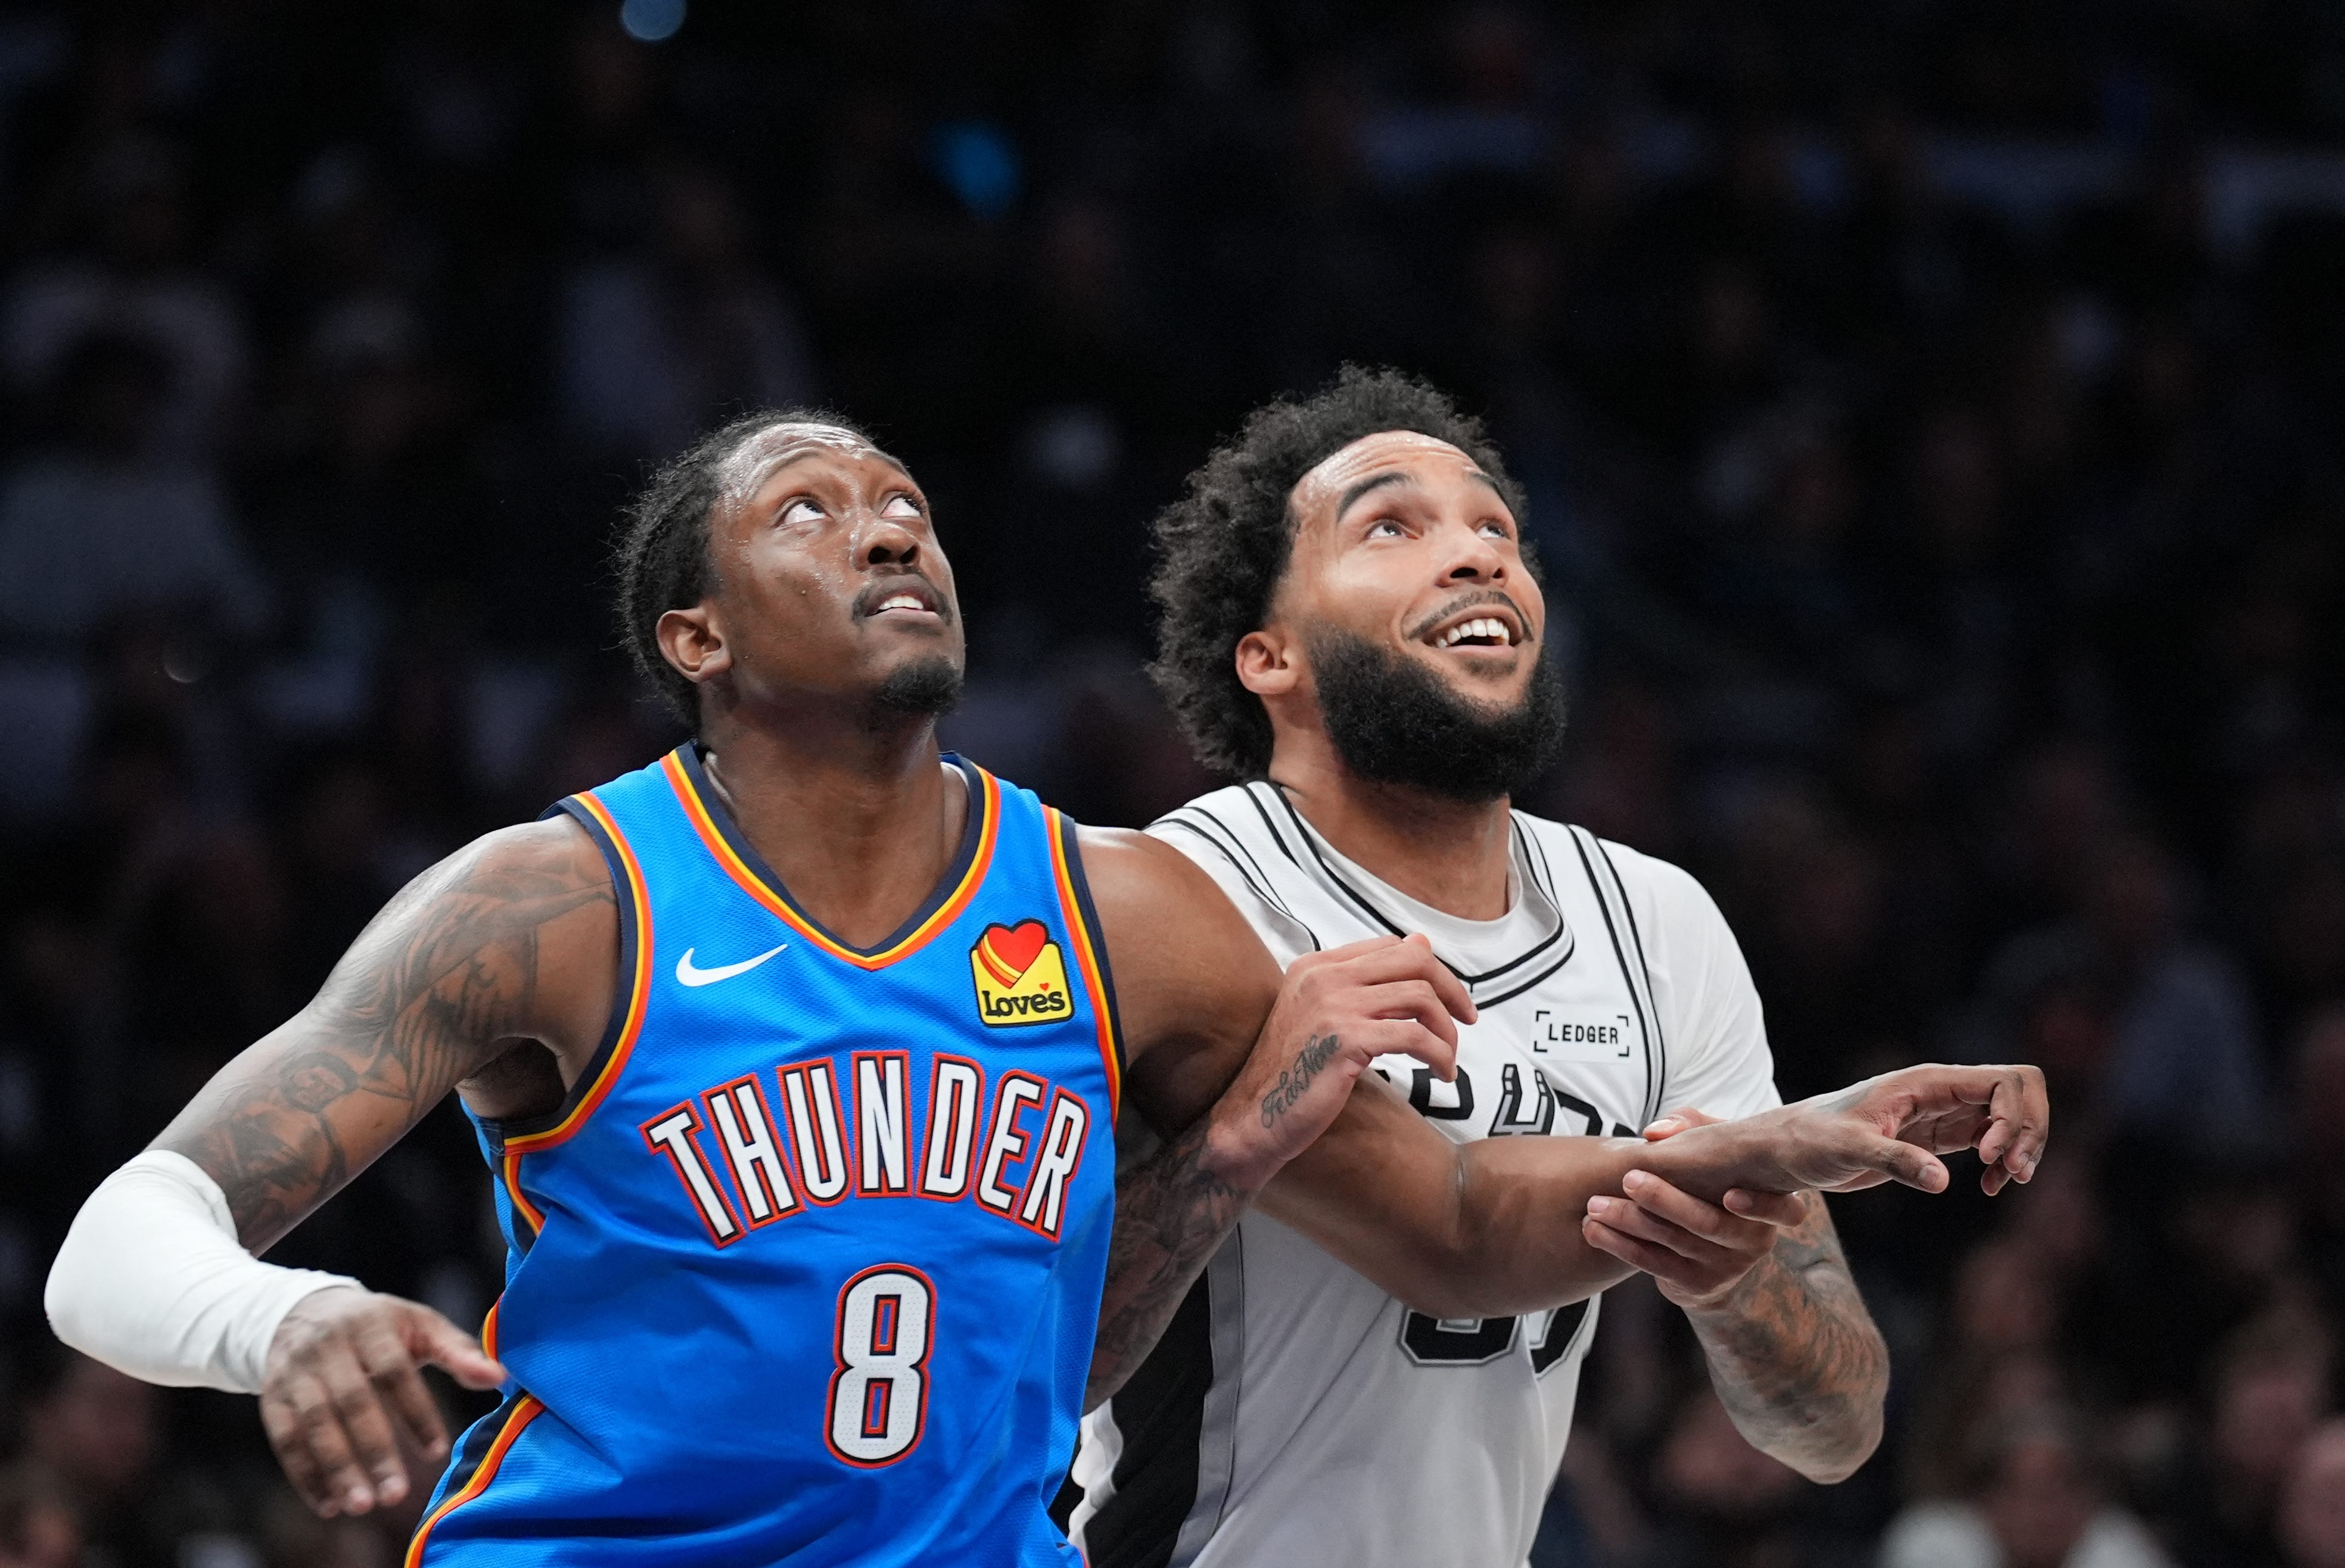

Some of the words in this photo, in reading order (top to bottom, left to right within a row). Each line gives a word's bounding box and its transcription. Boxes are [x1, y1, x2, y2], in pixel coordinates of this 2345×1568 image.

[1548, 1023, 1619, 1044] LEDGER
[638, 1050, 1091, 1249] THUNDER
[823, 1263, 937, 1469] 8
